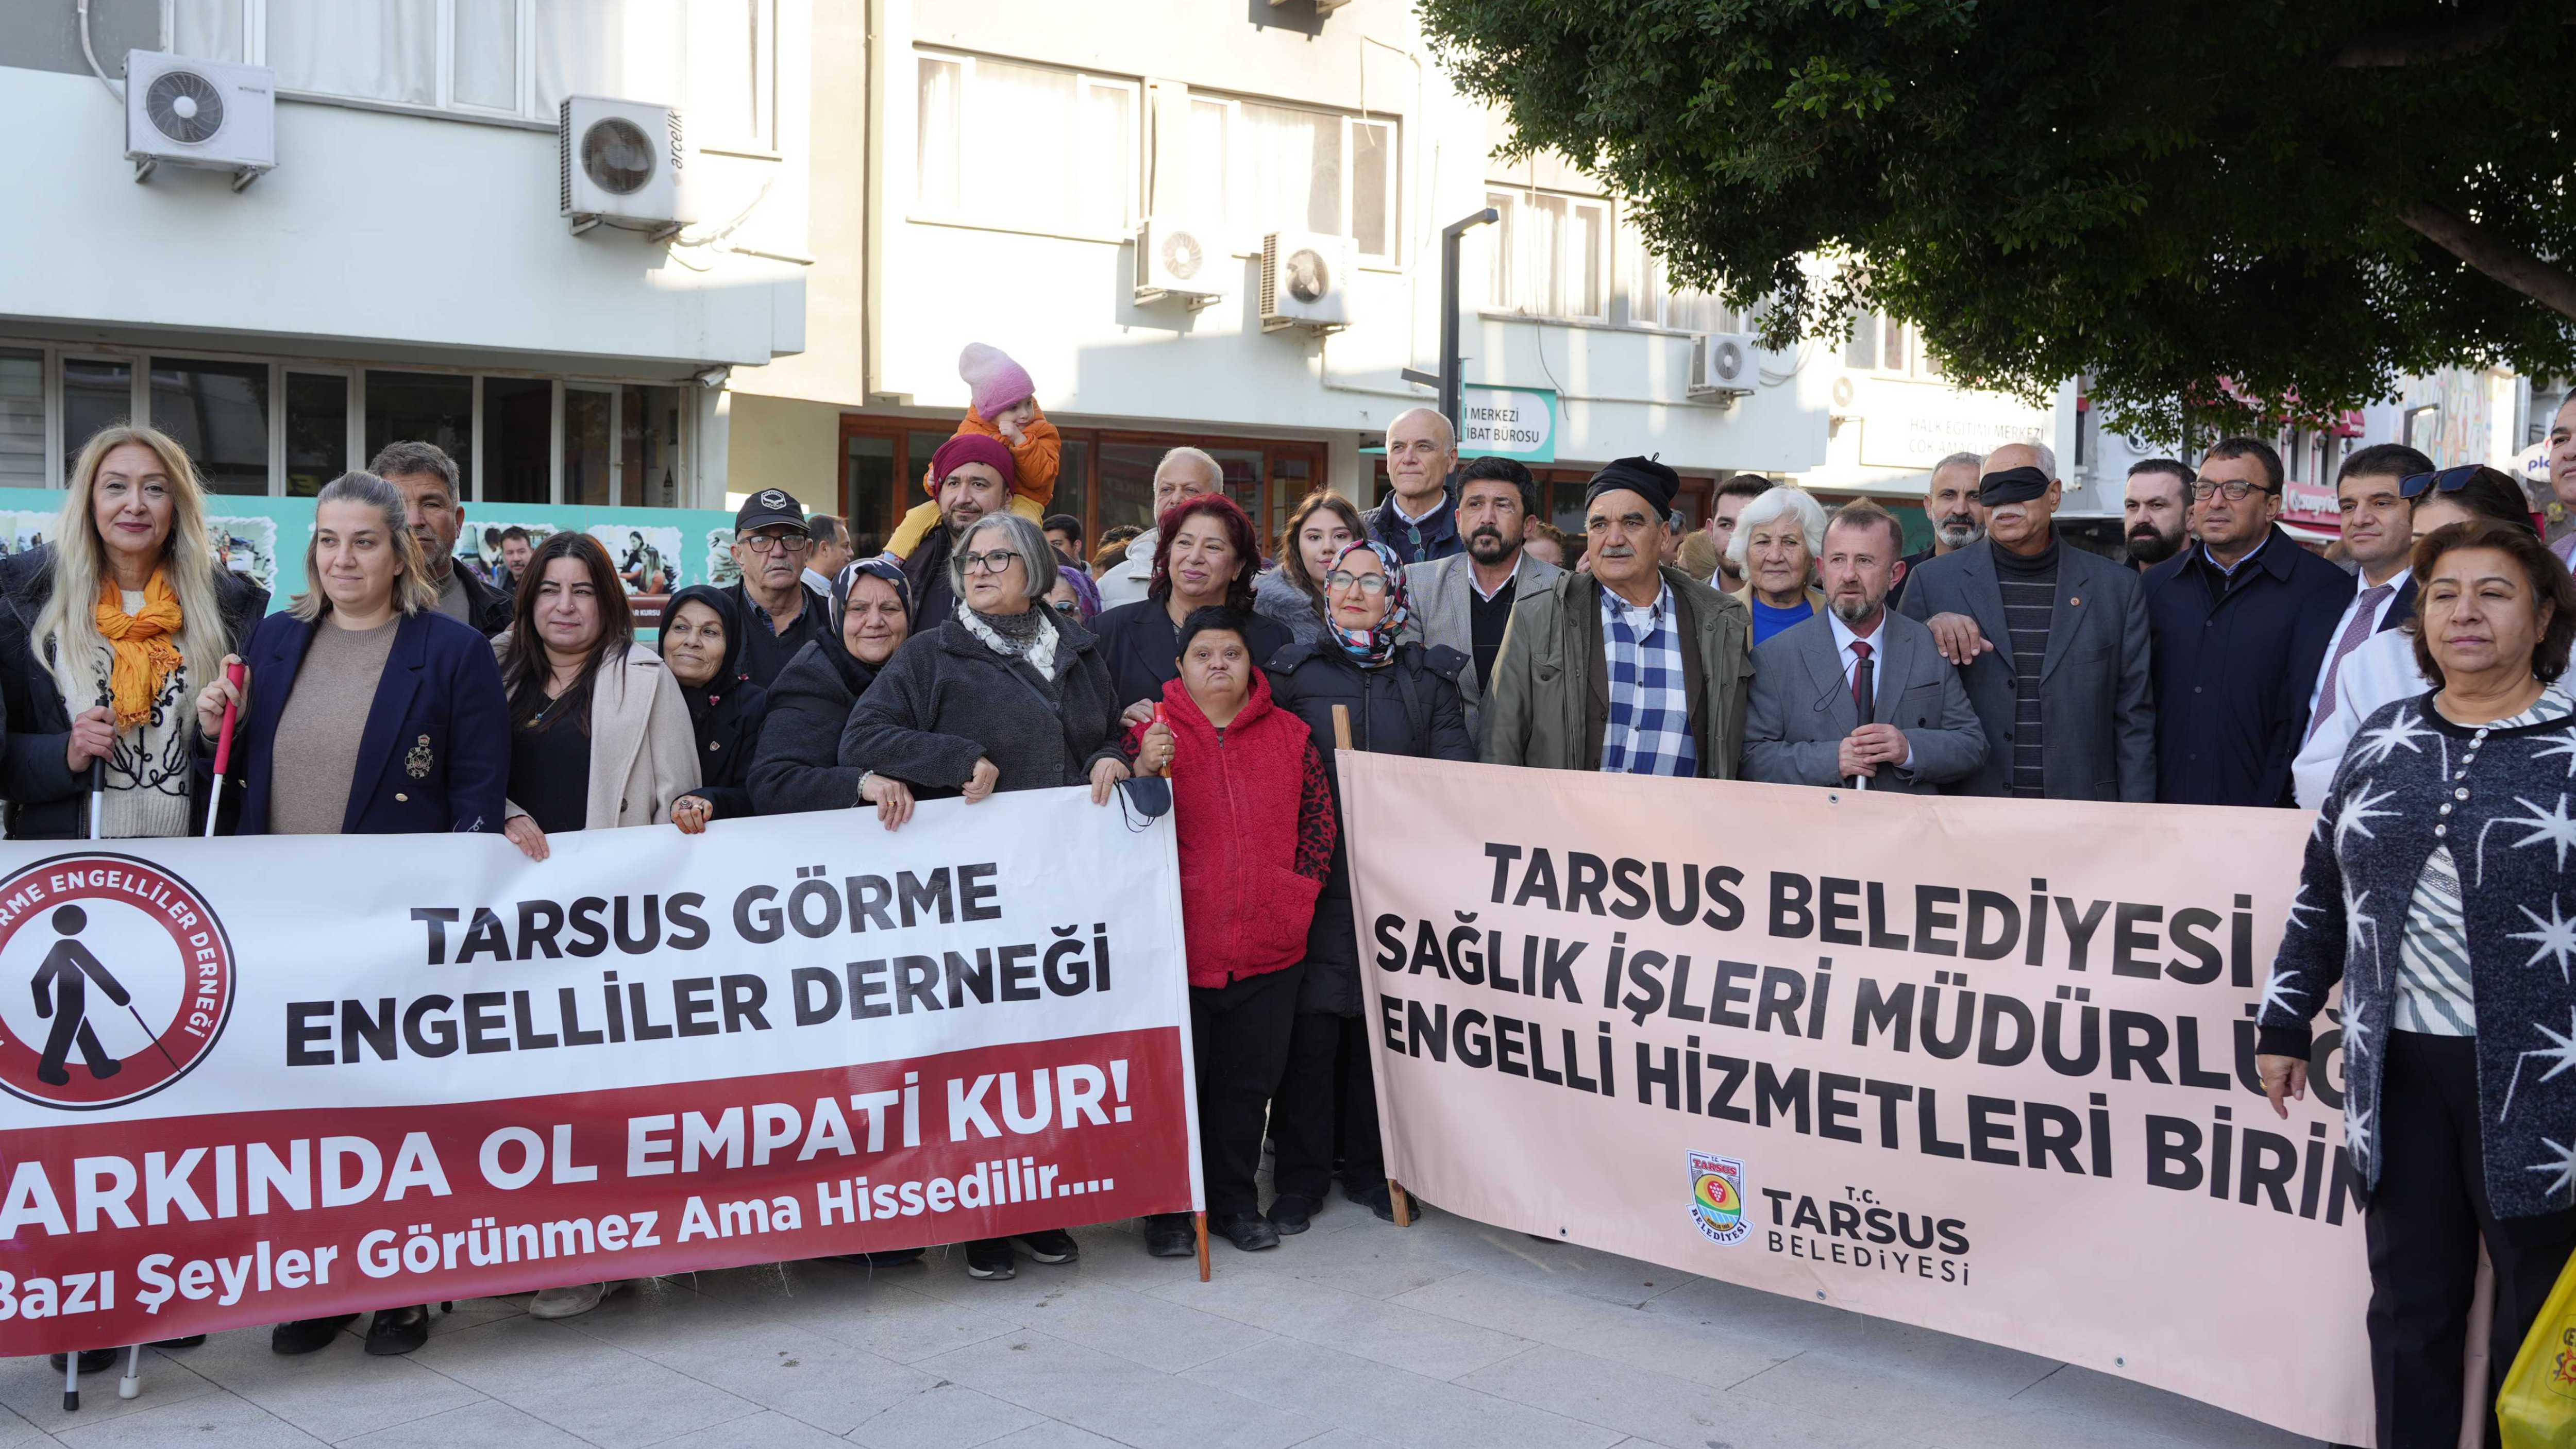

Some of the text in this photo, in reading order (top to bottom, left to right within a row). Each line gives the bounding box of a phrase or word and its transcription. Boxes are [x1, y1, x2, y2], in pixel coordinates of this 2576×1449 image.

[1465, 424, 1539, 443] İBAT BÜROSU
[1470, 408, 1519, 423] MERKEZİ
[1910, 419, 1942, 433] HALK
[1994, 424, 2045, 441] MERKEZİ
[50, 869, 197, 930] ENGELLİLER
[184, 931, 217, 1038] DERNEĞİ
[410, 862, 1002, 965] TARSUS GÖRME
[1485, 842, 2253, 988] TARSUS BELEDİYESİ
[286, 922, 1111, 1066] ENGELLİLER DERNEĞİ
[1374, 910, 1589, 1005] SAĞLIK
[1603, 932, 1832, 1040] İŞLERİ
[479, 1124, 597, 1191] OL
[627, 1072, 920, 1178] EMPATİ
[947, 1058, 1133, 1143] KUR!
[1380, 993, 1615, 1097] ENGELLİ
[1636, 1036, 2112, 1178] HİZMETLERİ
[1693, 1158, 1737, 1176] TARSUS
[1845, 1186, 1880, 1205] T.C.
[135, 1240, 338, 1315] Şeyler
[357, 1211, 661, 1278] Görünmez
[677, 1195, 801, 1242] Ama
[1692, 1208, 1746, 1241] BELEDİYESİ
[1762, 1187, 1970, 1255] TARSUS
[1768, 1230, 1968, 1286] BELEDİYESİ
